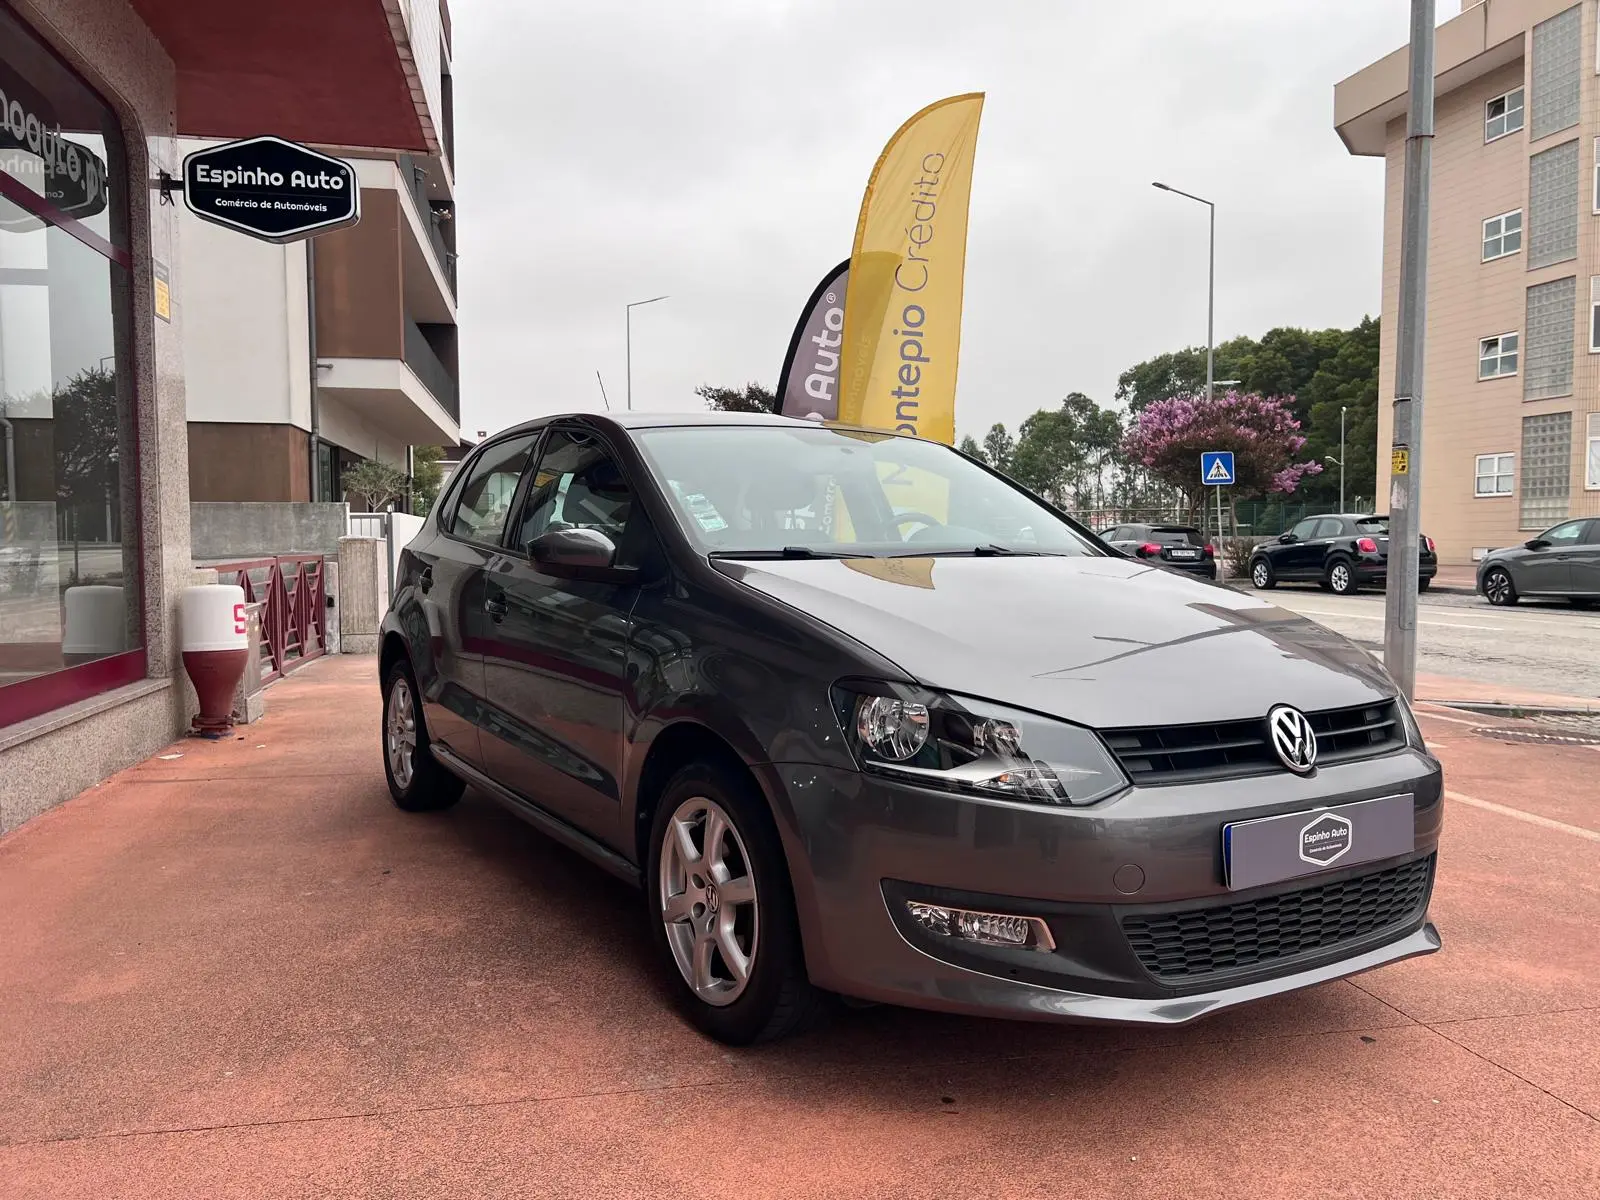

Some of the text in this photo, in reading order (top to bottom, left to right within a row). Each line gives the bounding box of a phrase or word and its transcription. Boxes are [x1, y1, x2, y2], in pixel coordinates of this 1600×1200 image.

[196, 164, 284, 188] Espinho
[215, 198, 328, 212] Comércio de Automóveis
[895, 153, 945, 291] Crédito
[1304, 827, 1348, 843] Espinho Auto
